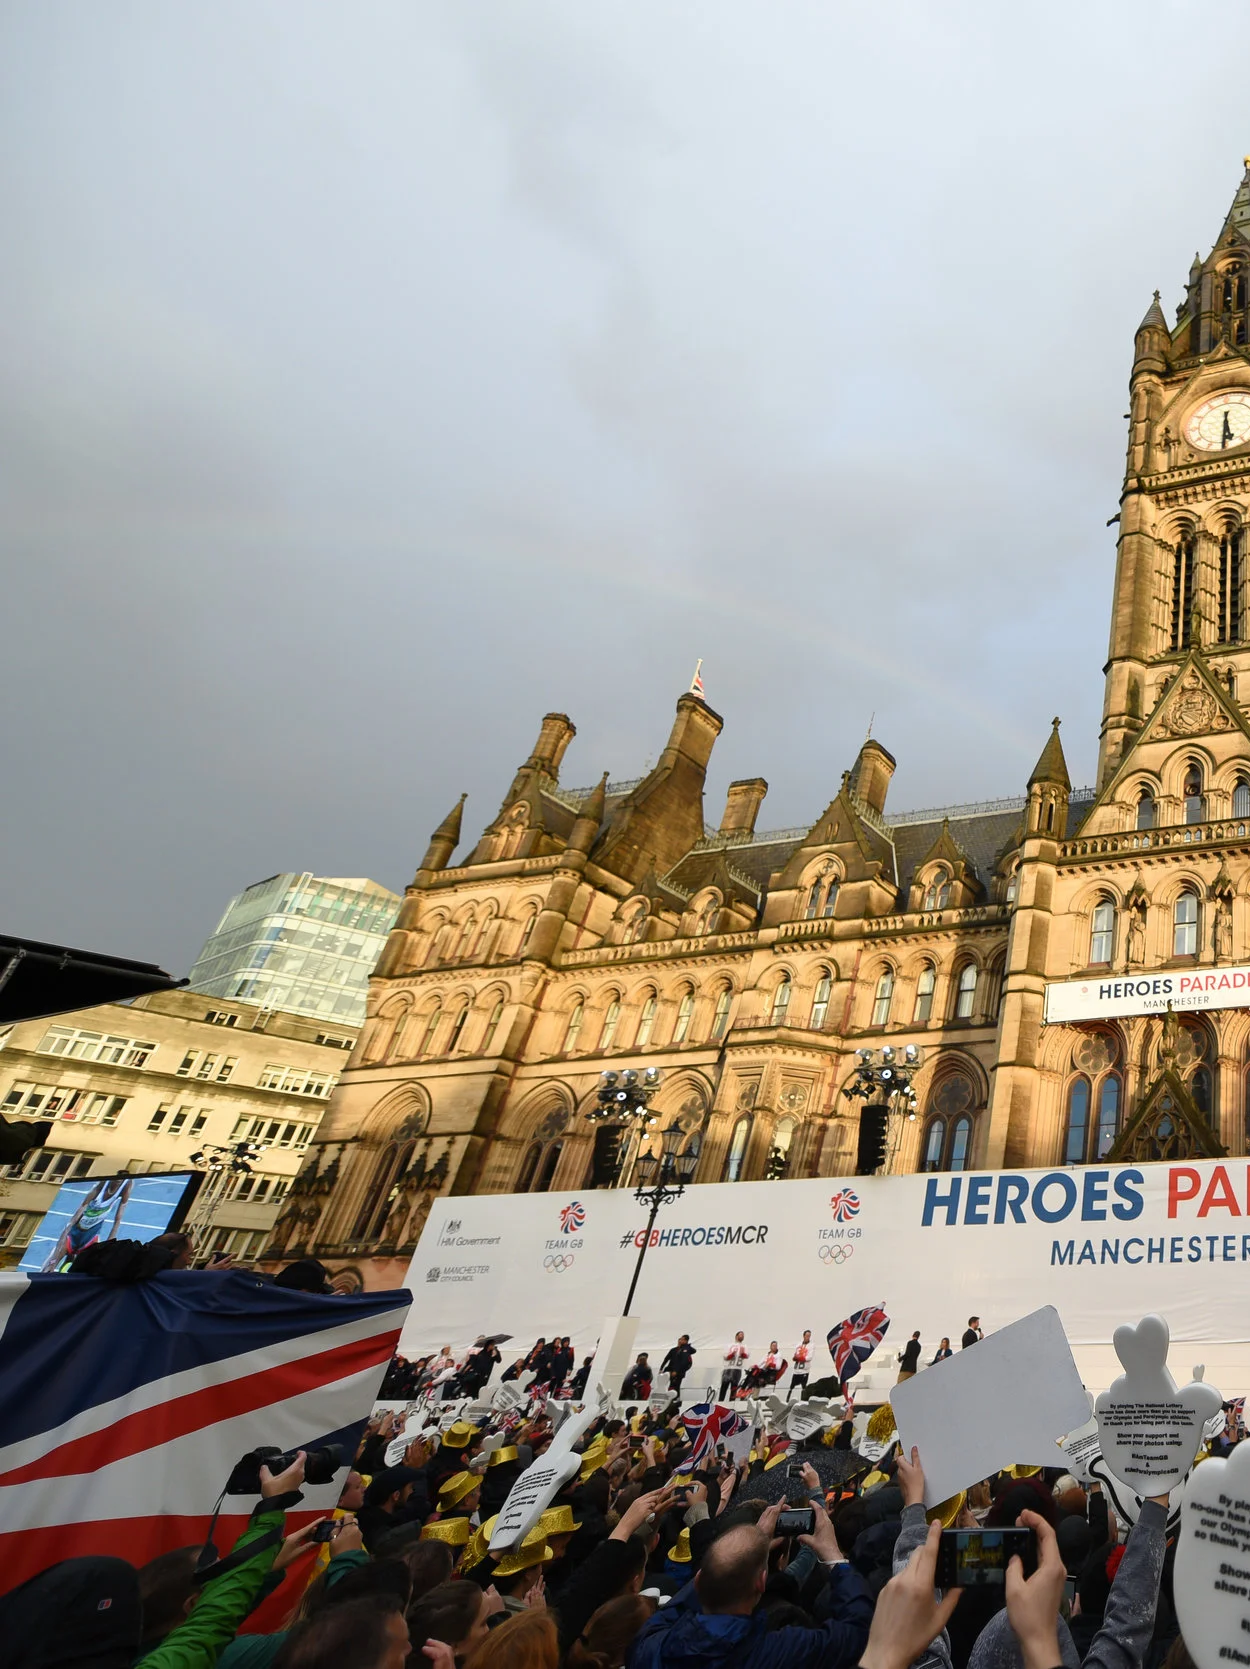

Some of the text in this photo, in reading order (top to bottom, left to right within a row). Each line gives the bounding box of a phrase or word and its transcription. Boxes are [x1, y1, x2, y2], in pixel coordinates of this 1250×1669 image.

[1099, 979, 1173, 999] HEROES
[921, 1169, 1145, 1227] HEROES
[441, 1236, 501, 1247] HM Government
[620, 1225, 769, 1249] #GBHEROESMCR
[818, 1228, 862, 1239] TEAM GB
[545, 1239, 584, 1250] TEAM GB
[443, 1265, 490, 1275] MANCHESTER
[1219, 1494, 1232, 1508] By
[1190, 1502, 1225, 1517] no-one
[1227, 1510, 1246, 1523] has
[1200, 1518, 1218, 1529] our
[1194, 1529, 1207, 1540] so
[1209, 1533, 1239, 1549] thank
[1214, 1580, 1248, 1598] share
